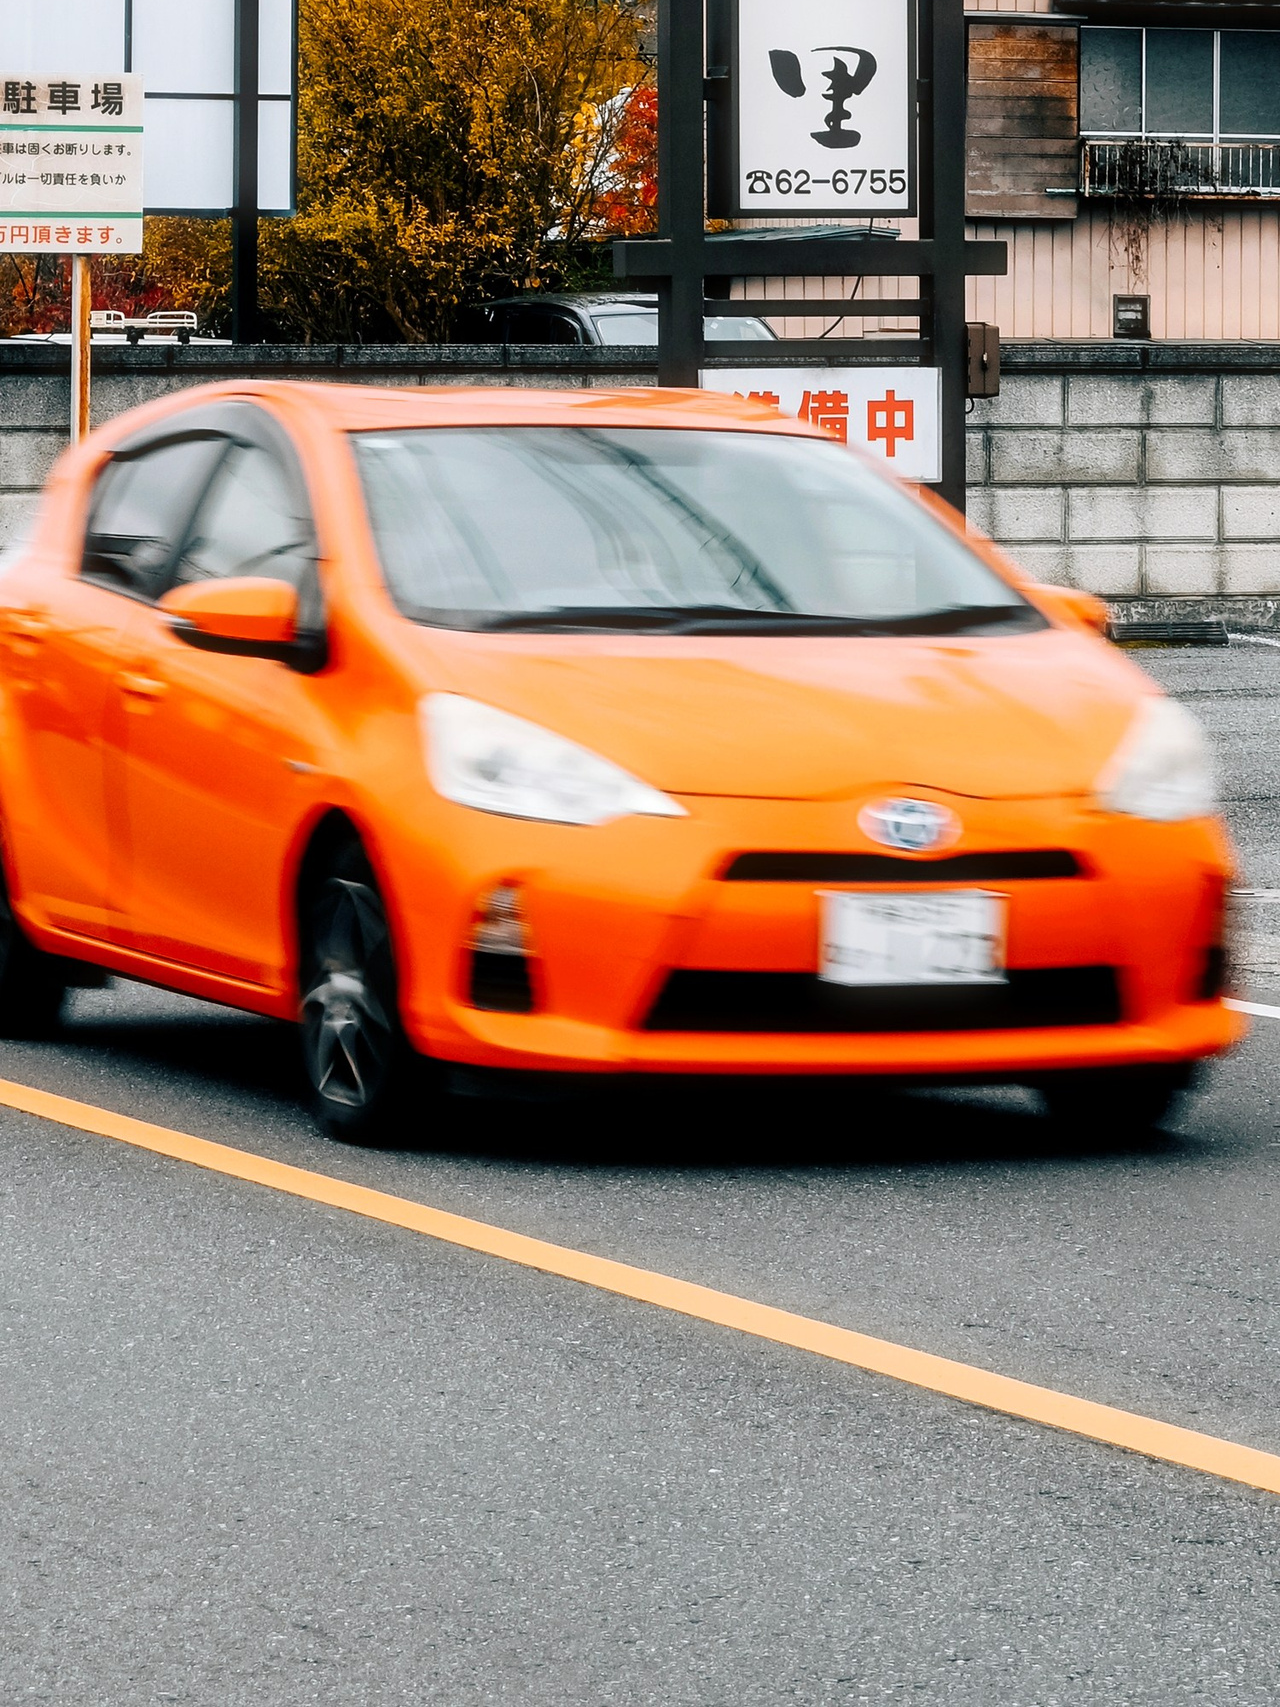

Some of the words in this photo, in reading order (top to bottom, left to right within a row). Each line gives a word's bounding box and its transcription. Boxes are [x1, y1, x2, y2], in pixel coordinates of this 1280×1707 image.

[3, 81, 123, 116] 駐車場
[0, 142, 132, 157] 車は固くお断りします。
[0, 172, 127, 186] ルは一切責任を負いか
[775, 169, 906, 195] 62-6755
[733, 389, 915, 457] 備中
